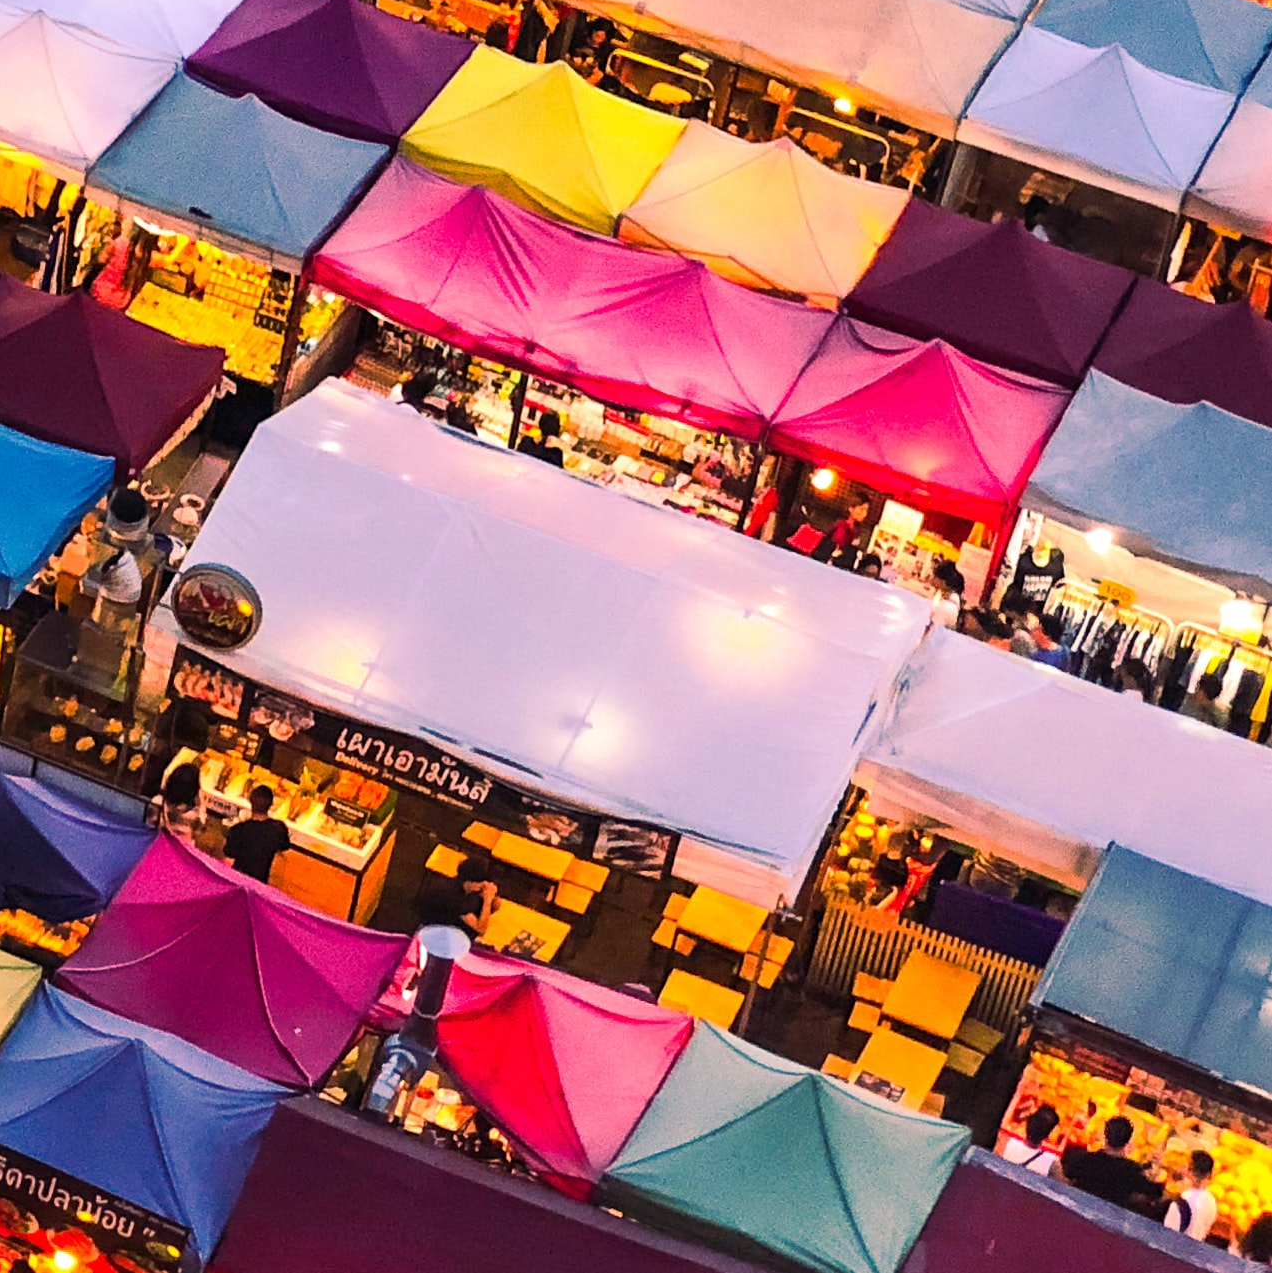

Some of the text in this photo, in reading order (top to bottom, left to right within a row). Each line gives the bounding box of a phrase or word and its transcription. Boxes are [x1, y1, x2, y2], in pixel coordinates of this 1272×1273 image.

[1107, 585, 1131, 601] 100
[335, 751, 379, 775] Delivery
[336, 728, 493, 804] เผาเอามันส์
